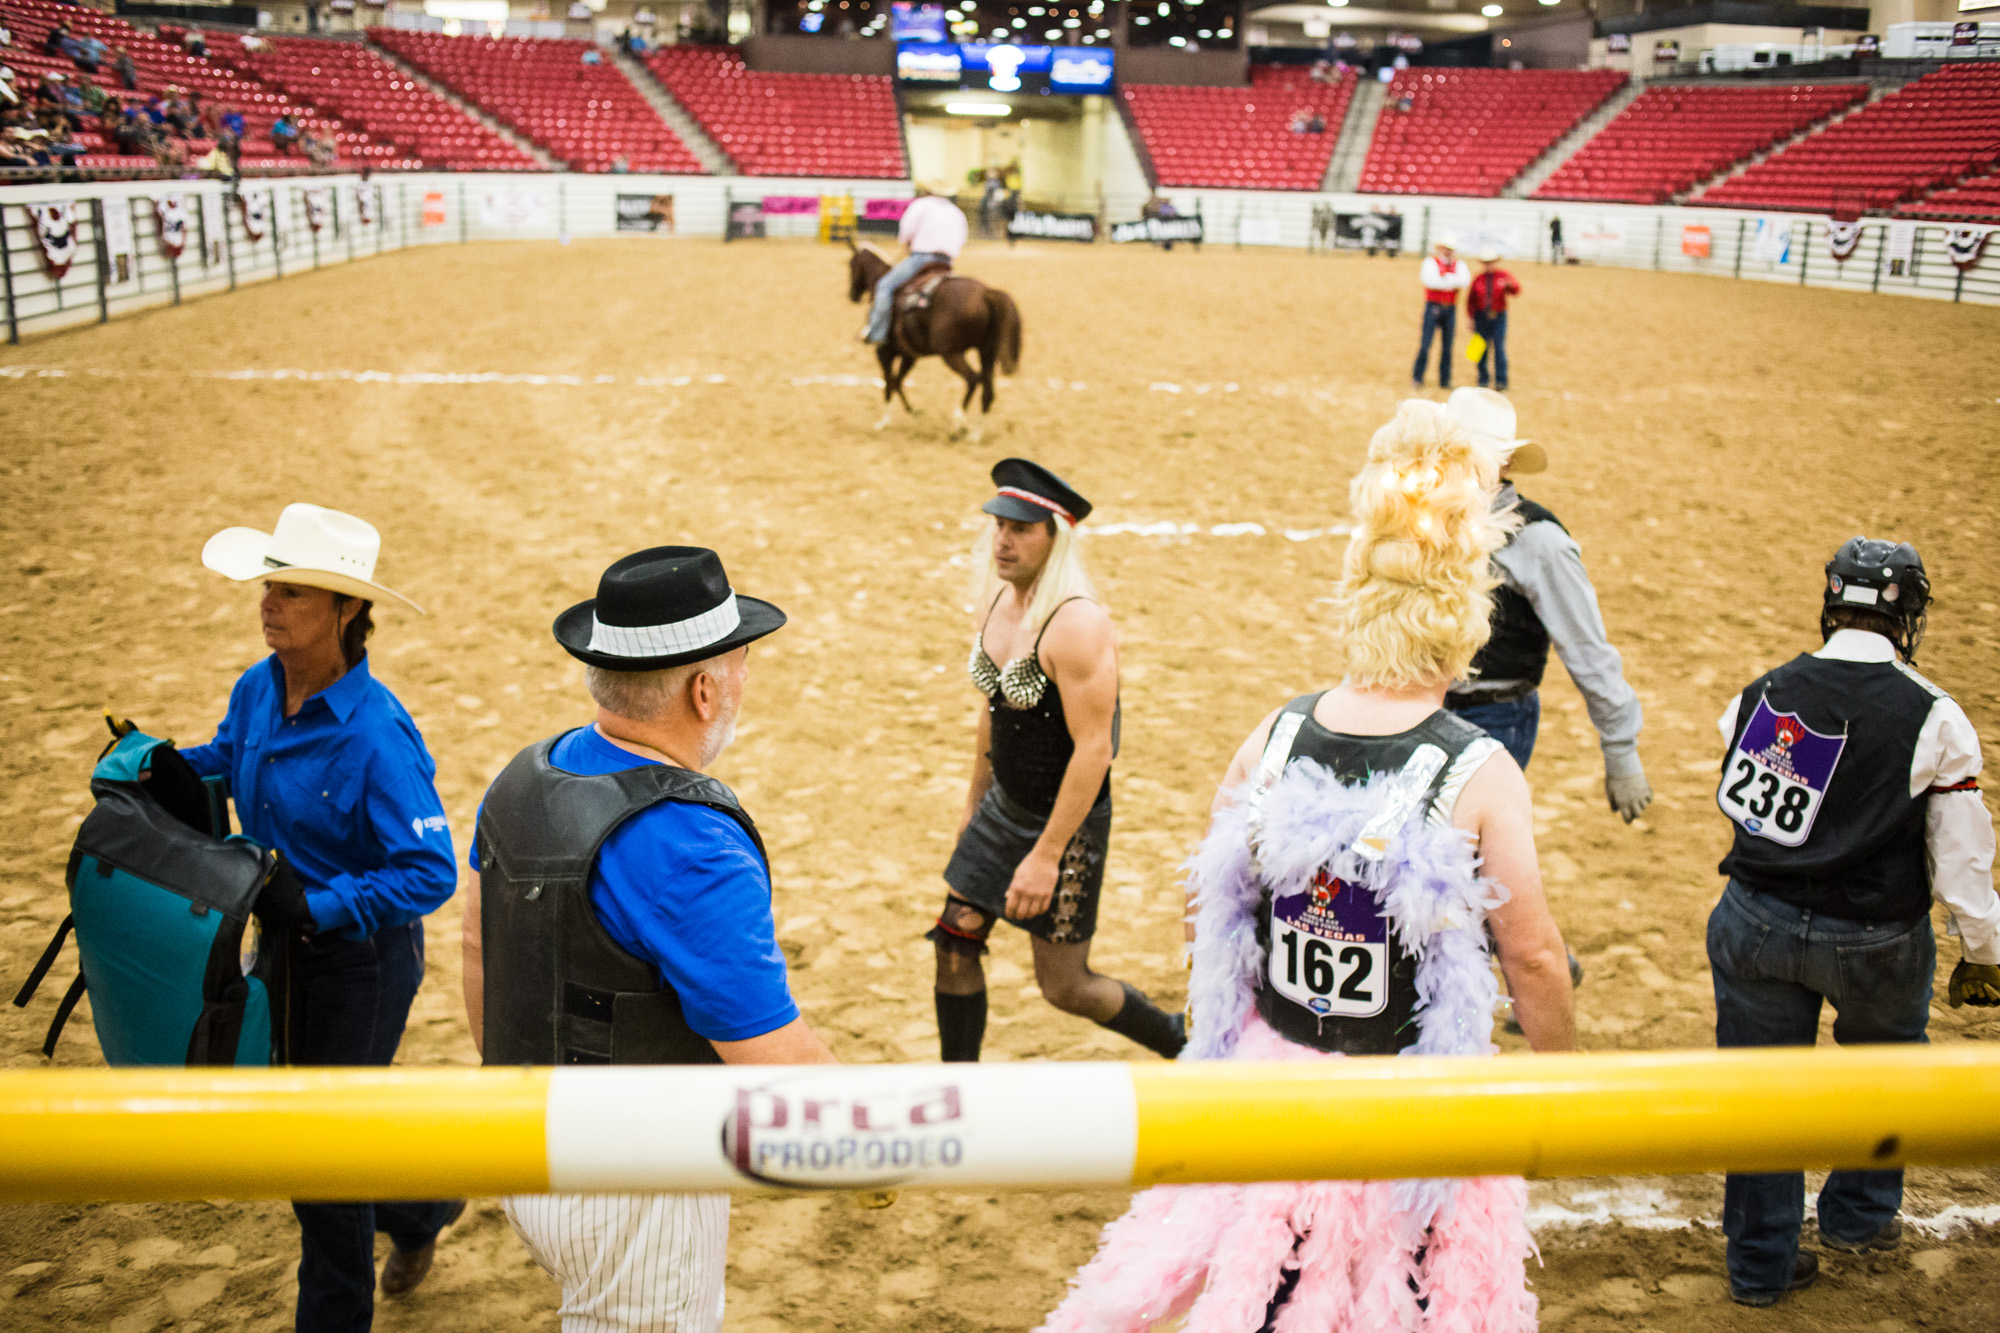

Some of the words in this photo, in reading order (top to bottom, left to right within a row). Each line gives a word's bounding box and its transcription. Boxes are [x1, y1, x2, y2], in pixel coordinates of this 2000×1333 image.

[1726, 758, 1811, 834] 238
[1286, 915, 1310, 933] LAS
[1313, 926, 1366, 942] VEGAS
[1307, 904, 1335, 919] 2015
[1281, 929, 1373, 1002] 162
